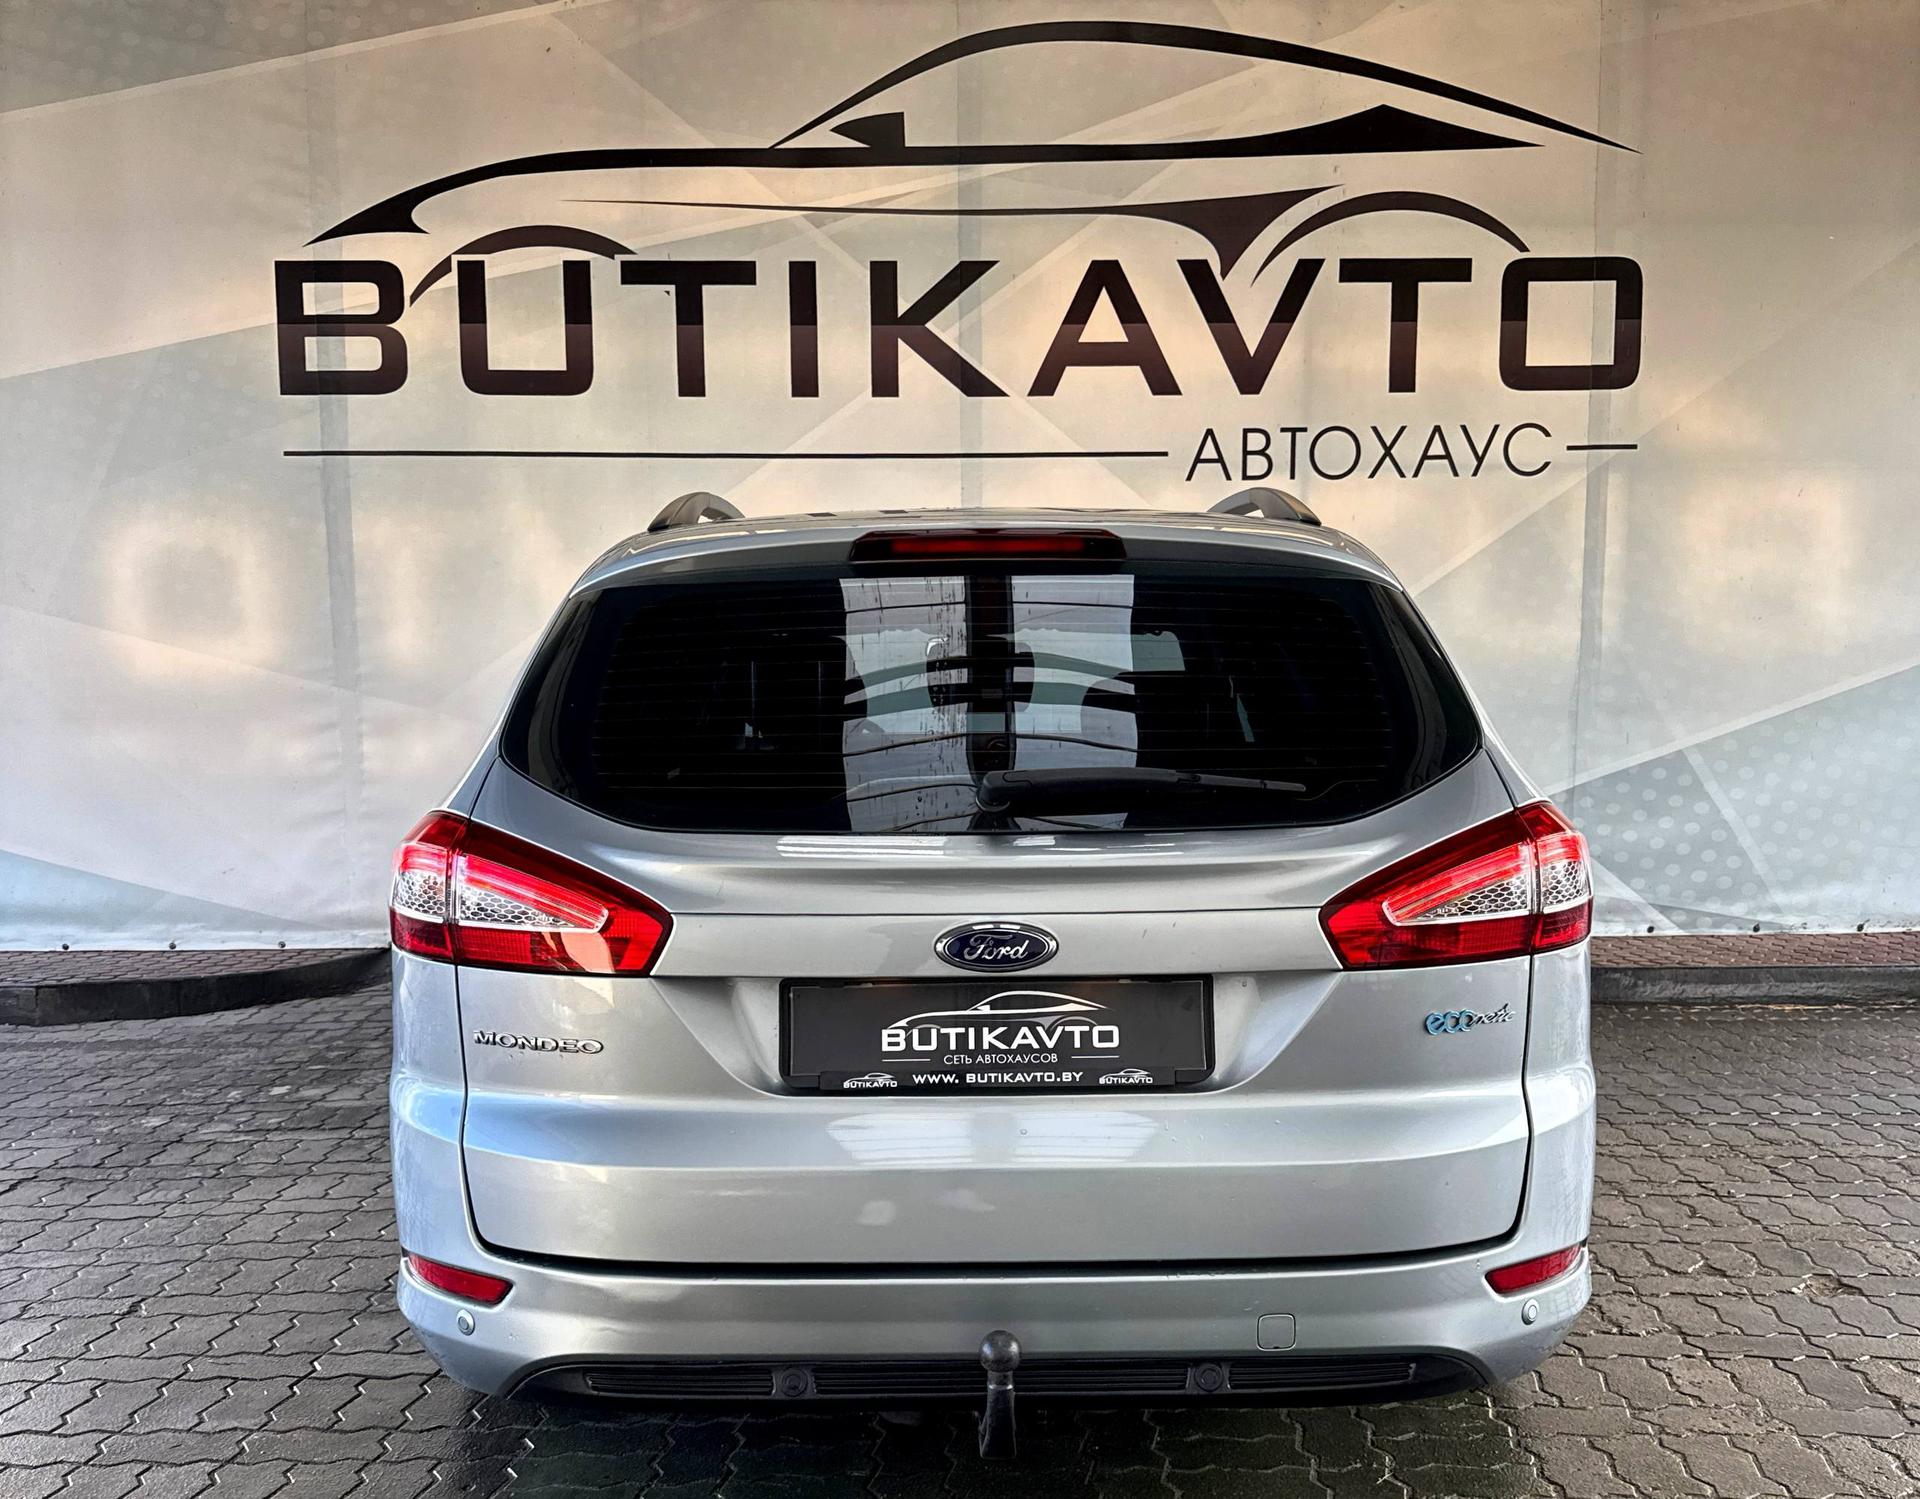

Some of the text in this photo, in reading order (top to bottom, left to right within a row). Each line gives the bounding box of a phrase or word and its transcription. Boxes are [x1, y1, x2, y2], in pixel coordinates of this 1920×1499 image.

[274, 256, 1643, 398] BUTIKAVTO
[1185, 422, 1552, 482] АВТОХАУС
[963, 933, 1030, 960] Ford
[473, 1029, 604, 1054] MONDEO
[881, 1024, 1120, 1052] BUTIKAVTO
[943, 1052, 1058, 1065] СЕТЬ АВТОХАУСОВ
[966, 1071, 1084, 1084] BUTIKAVTO.BY
